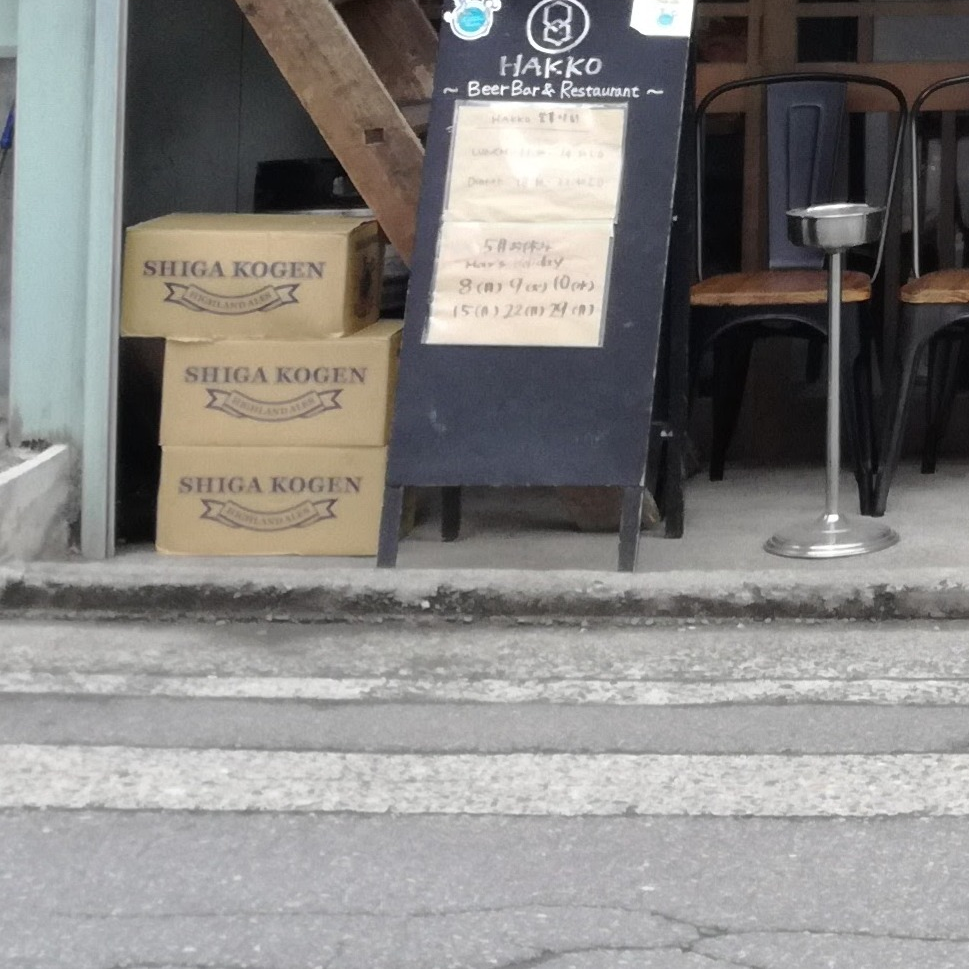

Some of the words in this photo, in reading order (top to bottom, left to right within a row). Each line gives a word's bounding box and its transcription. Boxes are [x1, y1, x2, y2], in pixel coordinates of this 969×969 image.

[499, 53, 604, 79] HAKKO
[467, 80, 511, 98] Beer
[511, 79, 540, 97] Bar
[541, 82, 556, 96] &
[560, 80, 641, 99] Restaurant
[142, 260, 225, 279] SHIGA
[231, 260, 327, 279] KOGEN
[184, 366, 267, 384] SHIGA
[276, 366, 368, 384] KOGEN
[177, 476, 262, 495] SHIGA
[269, 476, 363, 495] KOGEN
